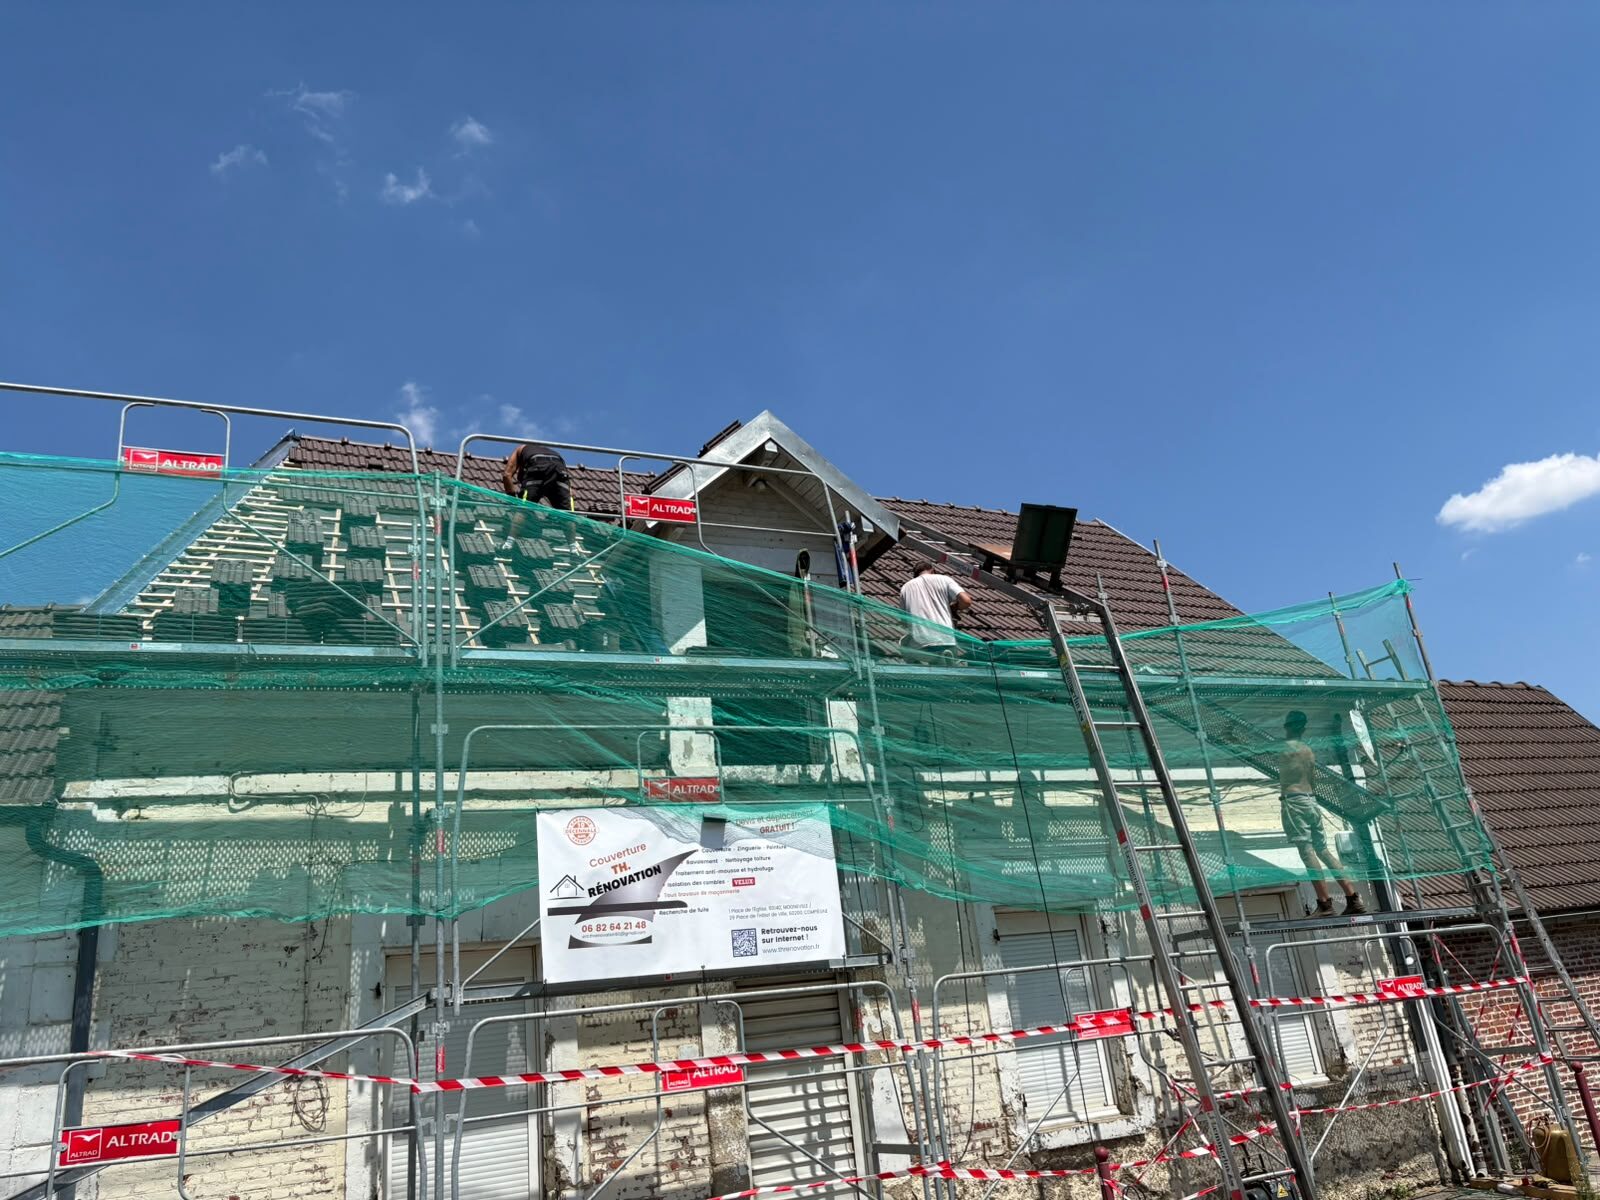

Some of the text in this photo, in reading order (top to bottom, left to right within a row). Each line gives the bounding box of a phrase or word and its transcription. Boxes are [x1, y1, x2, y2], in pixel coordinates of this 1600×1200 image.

[161, 459, 218, 471] ALTRAD
[651, 503, 691, 515] ALTRAD
[672, 784, 715, 794] ALTRAD
[735, 816, 756, 825] Devis
[766, 809, 815, 823] déplacement
[759, 823, 790, 834] GRATUIT
[589, 842, 647, 868] Couverture
[611, 862, 631, 875] TH.
[675, 869, 704, 877] Traitement
[747, 866, 774, 874] hydrofuge
[587, 864, 662, 898] RÉNOVATION
[733, 878, 754, 887] VELUX
[708, 888, 740, 896] maçonnerie
[659, 908, 688, 916] Recherche
[581, 920, 647, 933] 06 82 64 21 48
[761, 925, 818, 935] Retrouvez-nous
[775, 934, 804, 943] Internet
[762, 944, 820, 954] www.threnovation.fr
[692, 1064, 738, 1079] ALTRAD
[106, 1131, 172, 1149] ALTRAD
[70, 1149, 97, 1159] ALTRAD
